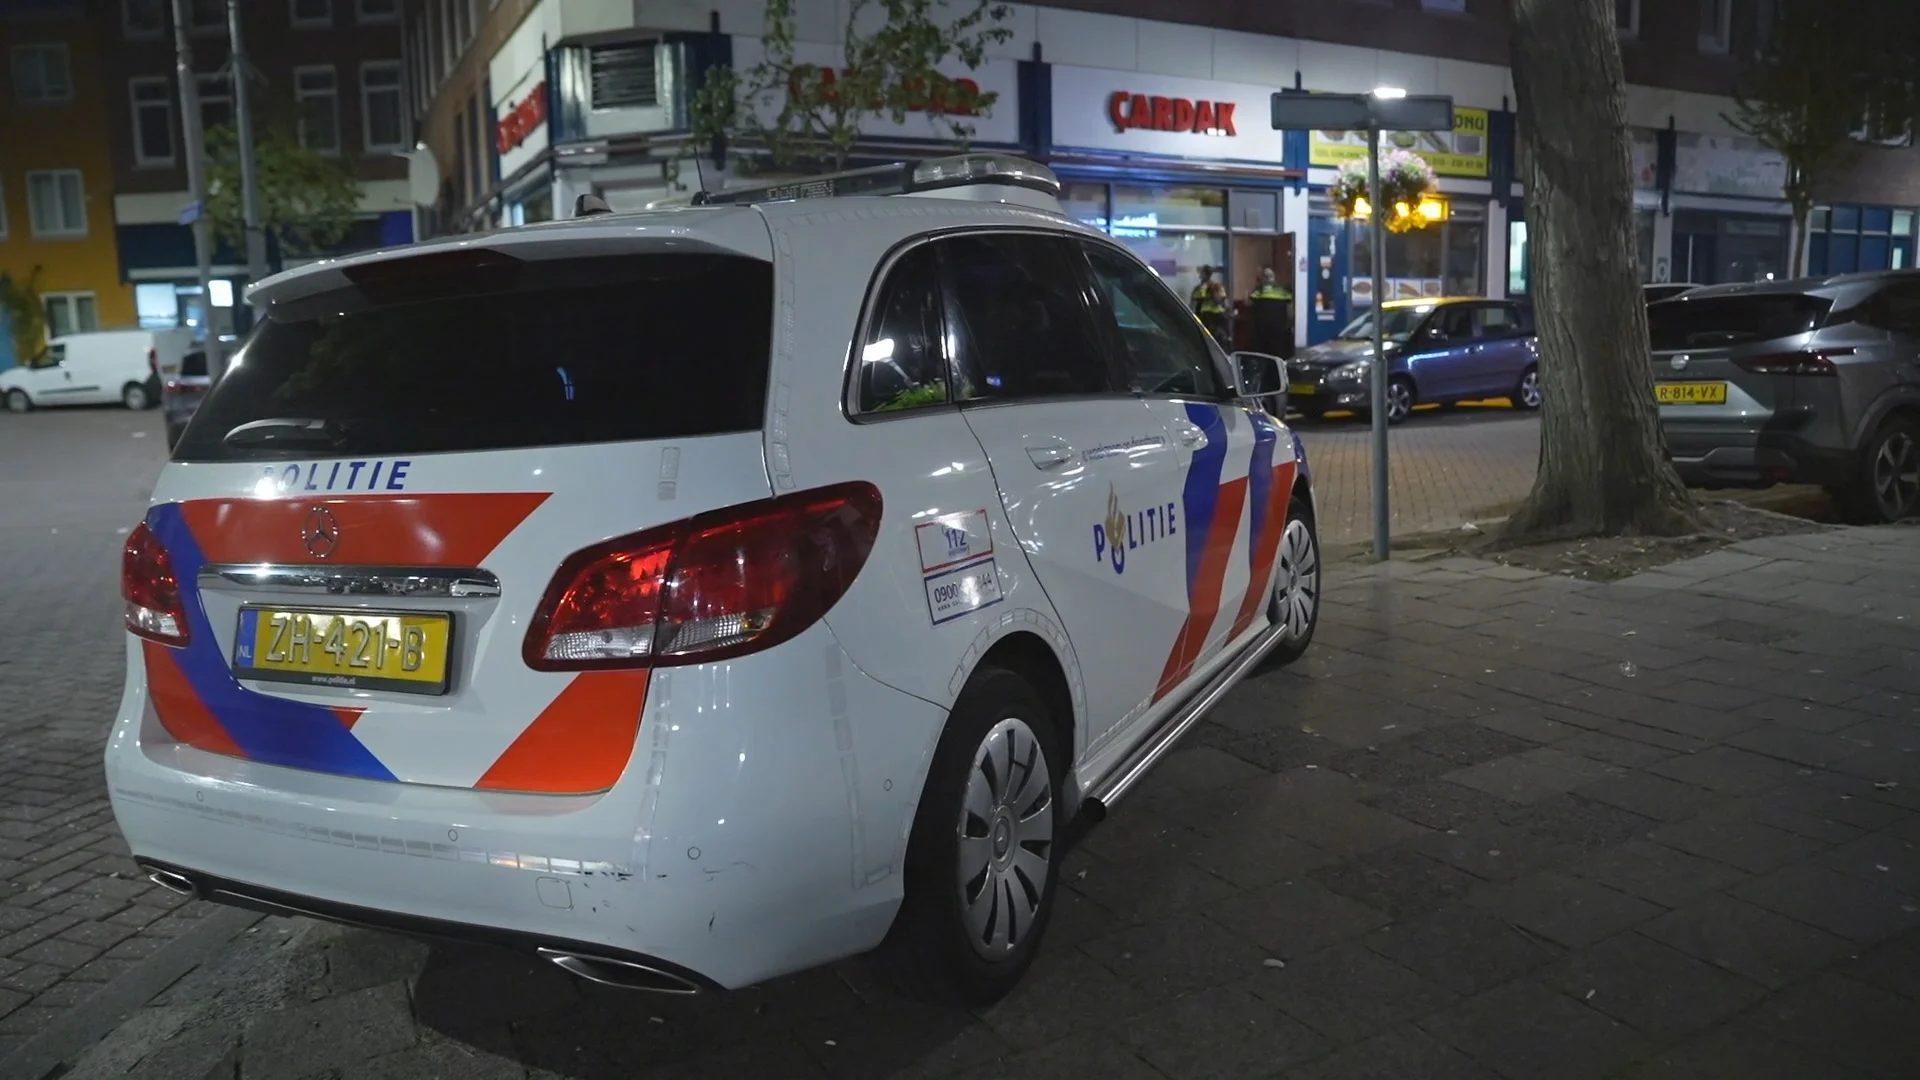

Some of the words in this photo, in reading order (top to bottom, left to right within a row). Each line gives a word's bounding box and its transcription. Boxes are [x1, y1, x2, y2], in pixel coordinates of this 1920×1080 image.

[1109, 91, 1237, 136] ÇARDAK
[1660, 386, 1717, 400] R-814-VX
[1093, 502, 1176, 575] POLITIE
[238, 645, 252, 659] NL
[265, 613, 426, 672] ZH-421-B
